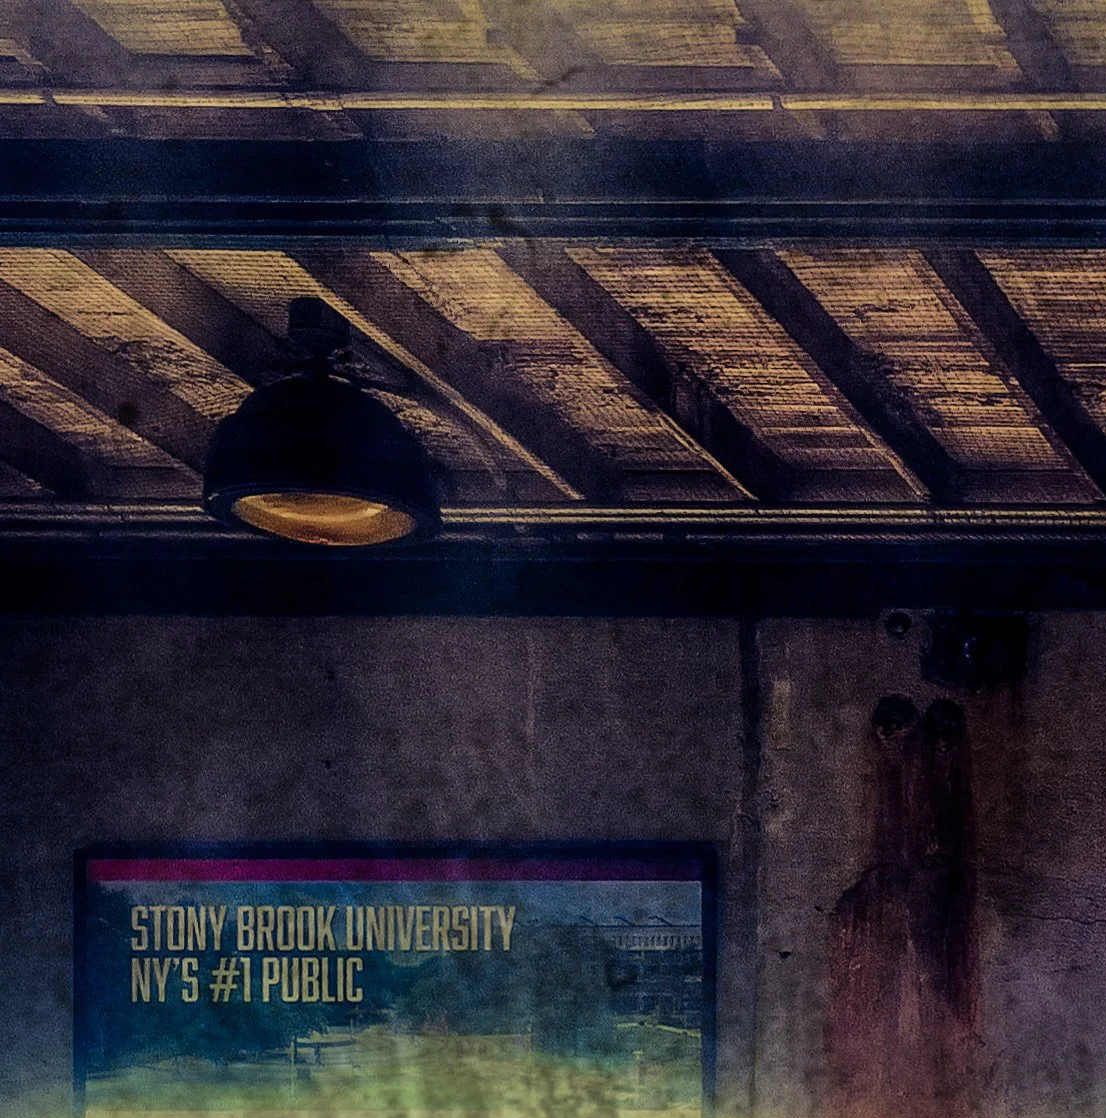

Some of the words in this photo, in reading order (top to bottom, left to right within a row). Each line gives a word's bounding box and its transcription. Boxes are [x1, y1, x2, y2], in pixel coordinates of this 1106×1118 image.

[130, 904, 227, 952] STONY
[236, 904, 338, 952] BROOK
[345, 904, 517, 952] UNIVERSITY
[130, 957, 200, 1003] NY'S
[209, 957, 252, 1003] #1
[262, 957, 365, 1003] PUBLIC
